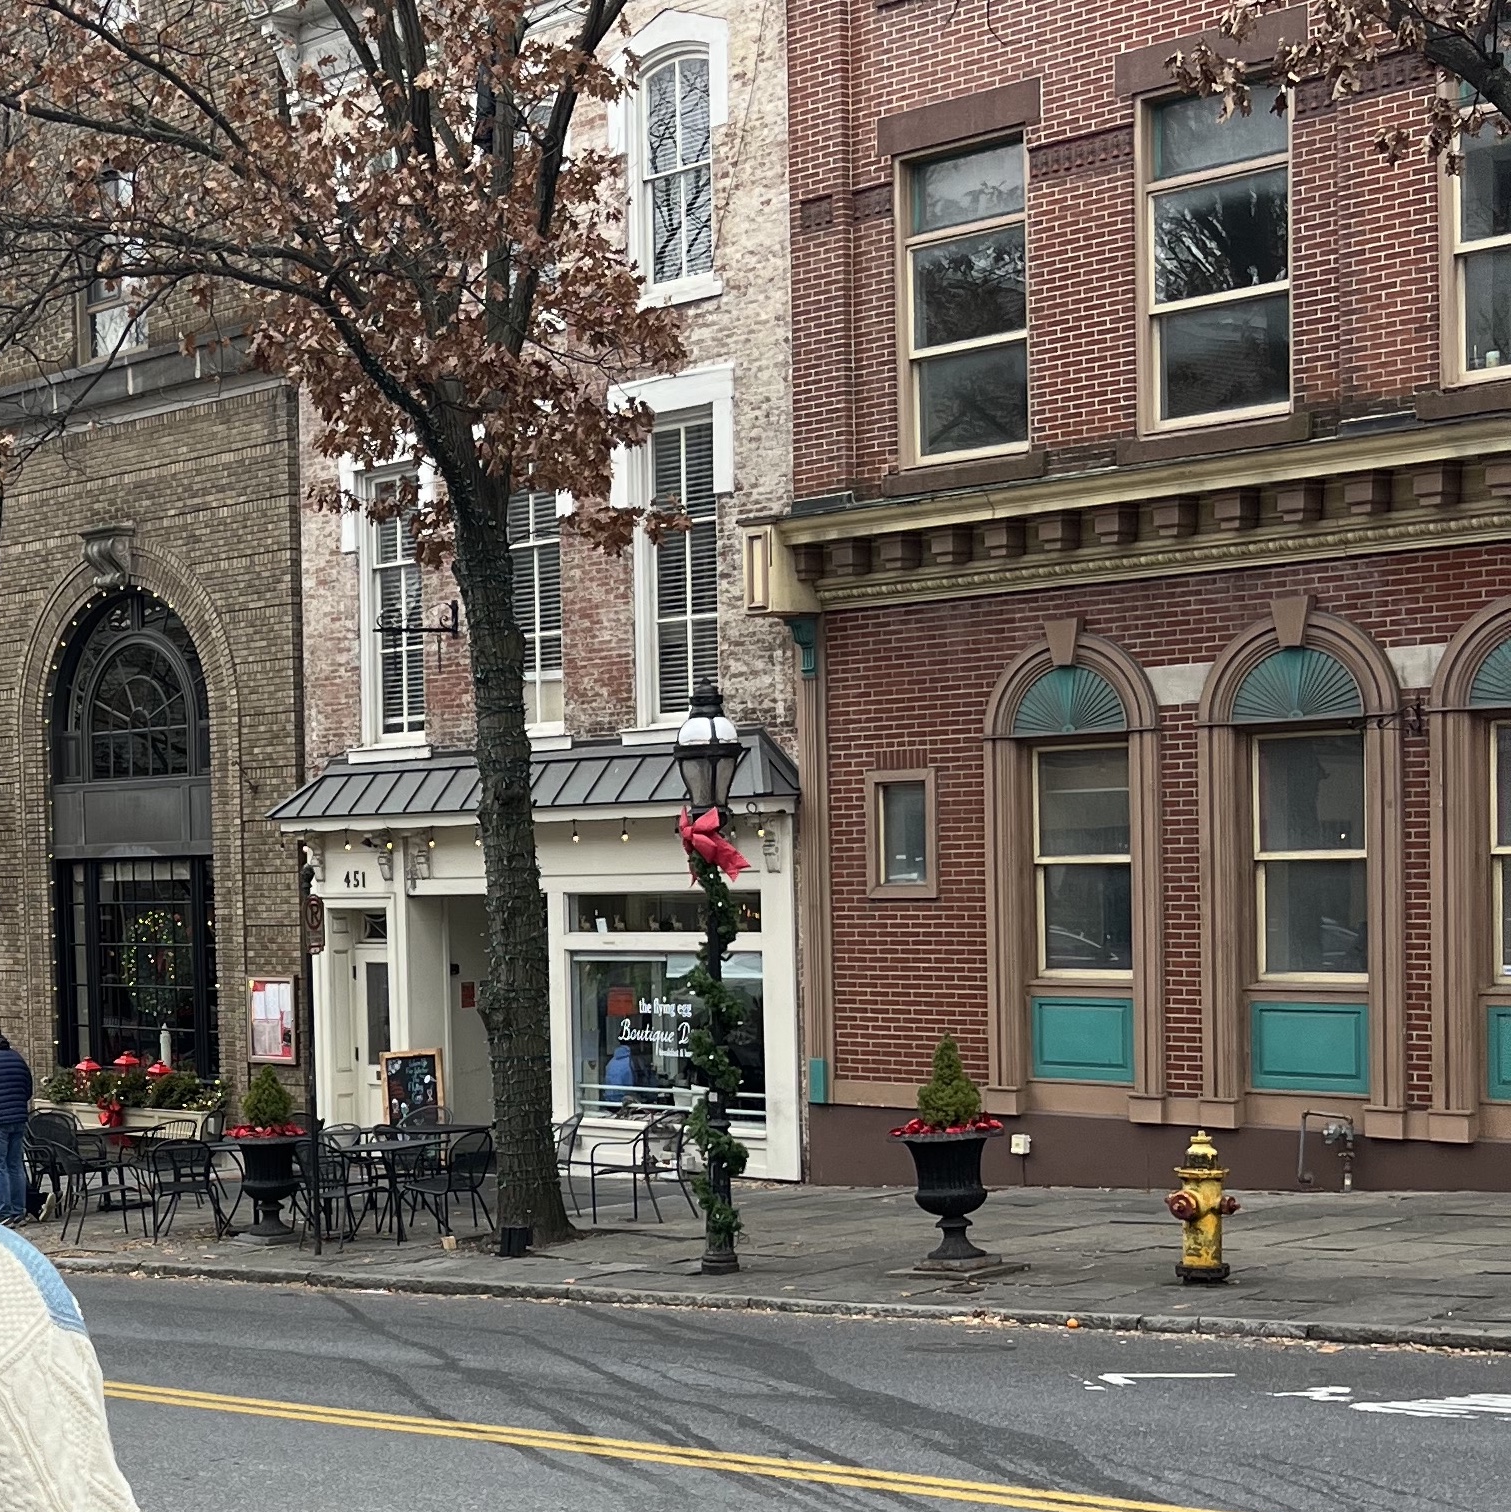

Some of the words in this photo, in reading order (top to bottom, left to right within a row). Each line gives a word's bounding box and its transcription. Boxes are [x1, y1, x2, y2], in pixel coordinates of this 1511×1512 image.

[344, 870, 366, 889] 451
[638, 997, 652, 1014] the
[676, 1003, 692, 1018] egg
[618, 1018, 675, 1055] Boutique
